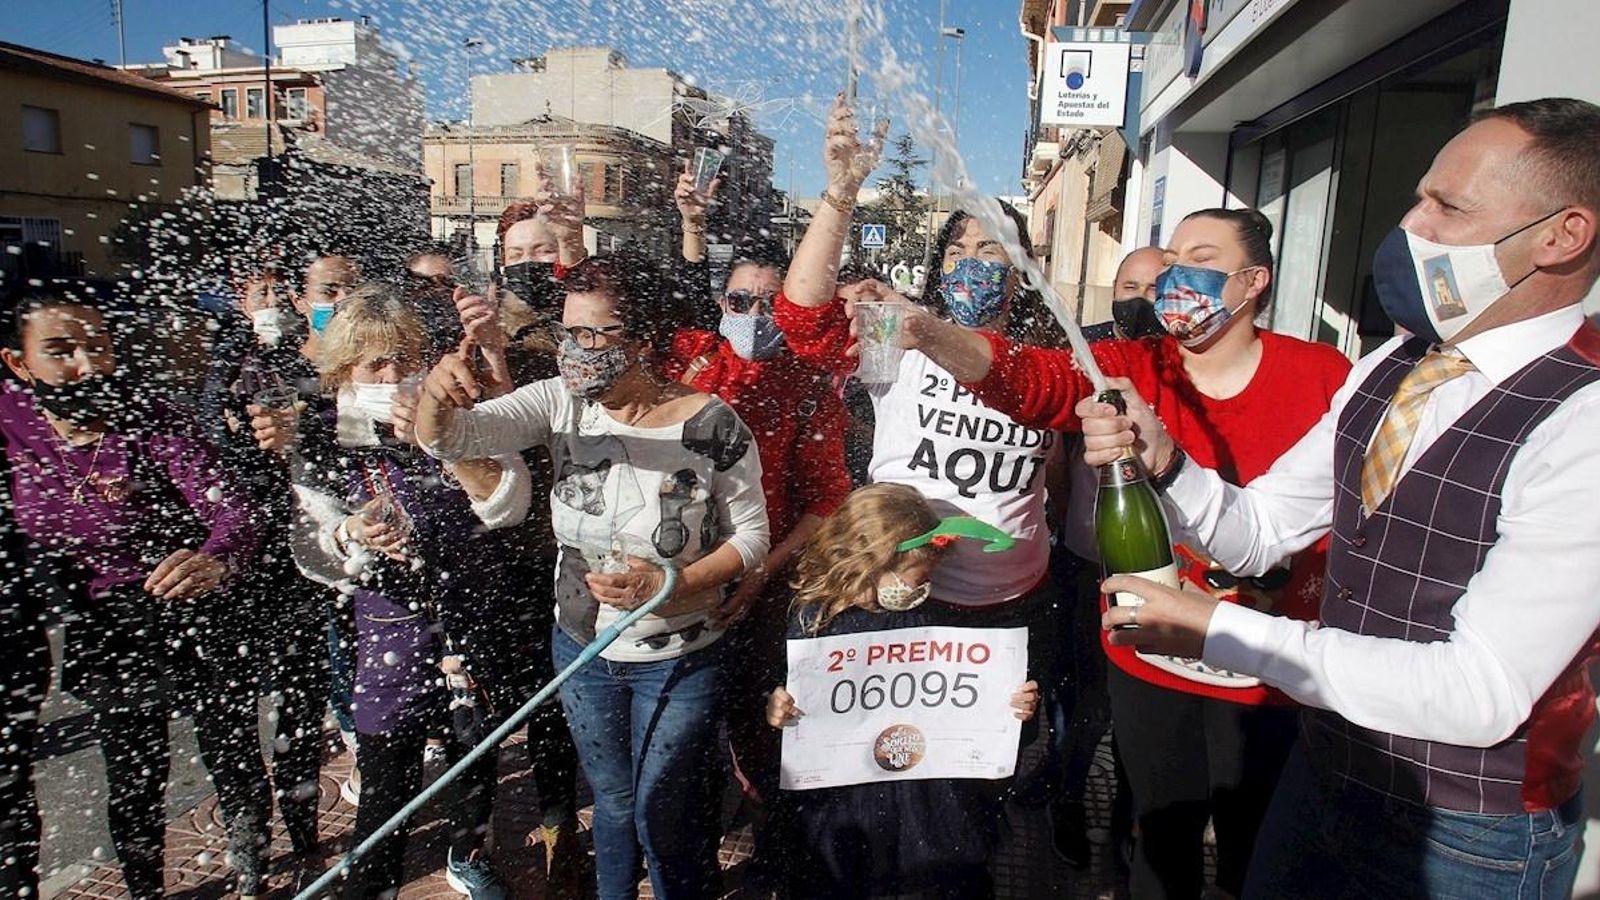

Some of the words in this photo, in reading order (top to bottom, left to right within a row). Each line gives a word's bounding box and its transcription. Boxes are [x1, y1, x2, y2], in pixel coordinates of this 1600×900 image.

[1057, 109, 1084, 117] Estado
[1058, 100, 1094, 109] Apuestas
[917, 404, 1054, 450] VENDIDO
[867, 640, 991, 666] PREMIO
[830, 670, 979, 714] 06095
